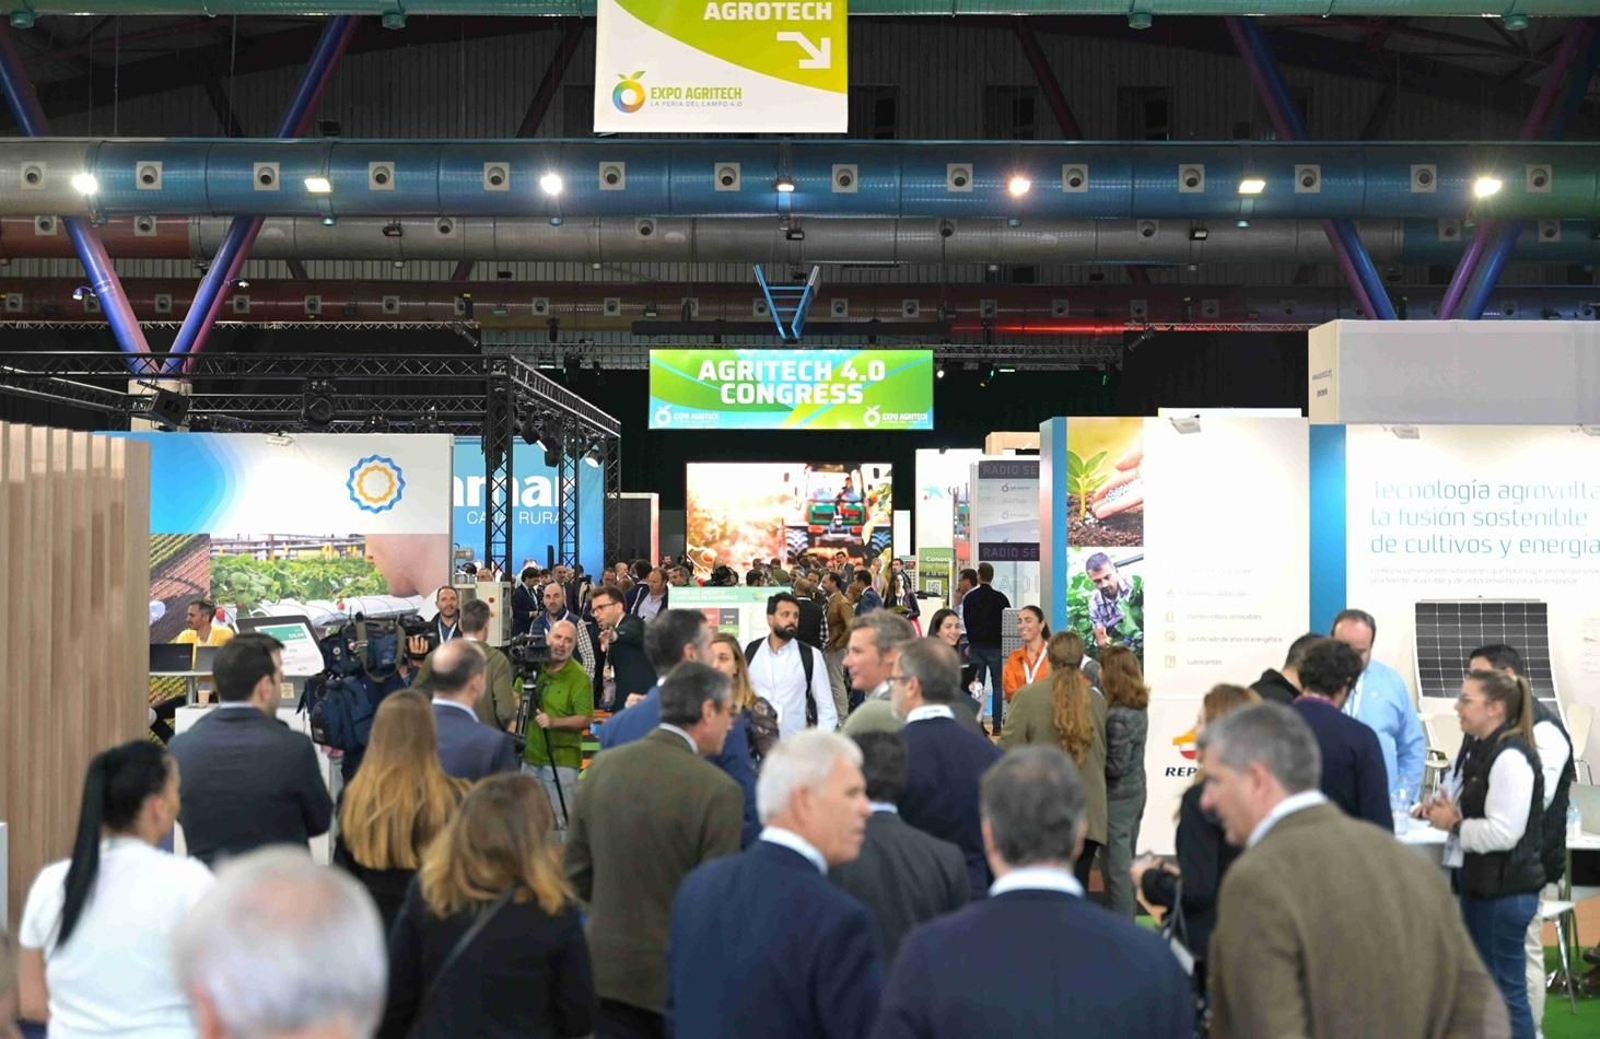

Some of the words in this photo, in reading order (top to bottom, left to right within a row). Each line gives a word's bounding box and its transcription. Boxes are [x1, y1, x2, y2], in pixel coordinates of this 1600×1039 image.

[704, 2, 832, 21] AGROTECH
[650, 87, 682, 99] EXPO
[685, 87, 742, 99] AGRITECH
[698, 360, 832, 381] AGRITECH
[841, 360, 885, 381] 4.0
[720, 383, 864, 404] CONGRESS
[1370, 507, 1391, 526] la
[1398, 506, 1465, 527] fusión
[1473, 507, 1588, 527] sostenible
[1370, 534, 1397, 553] de
[1405, 534, 1493, 554] cultivos
[1499, 538, 1512, 558] y
